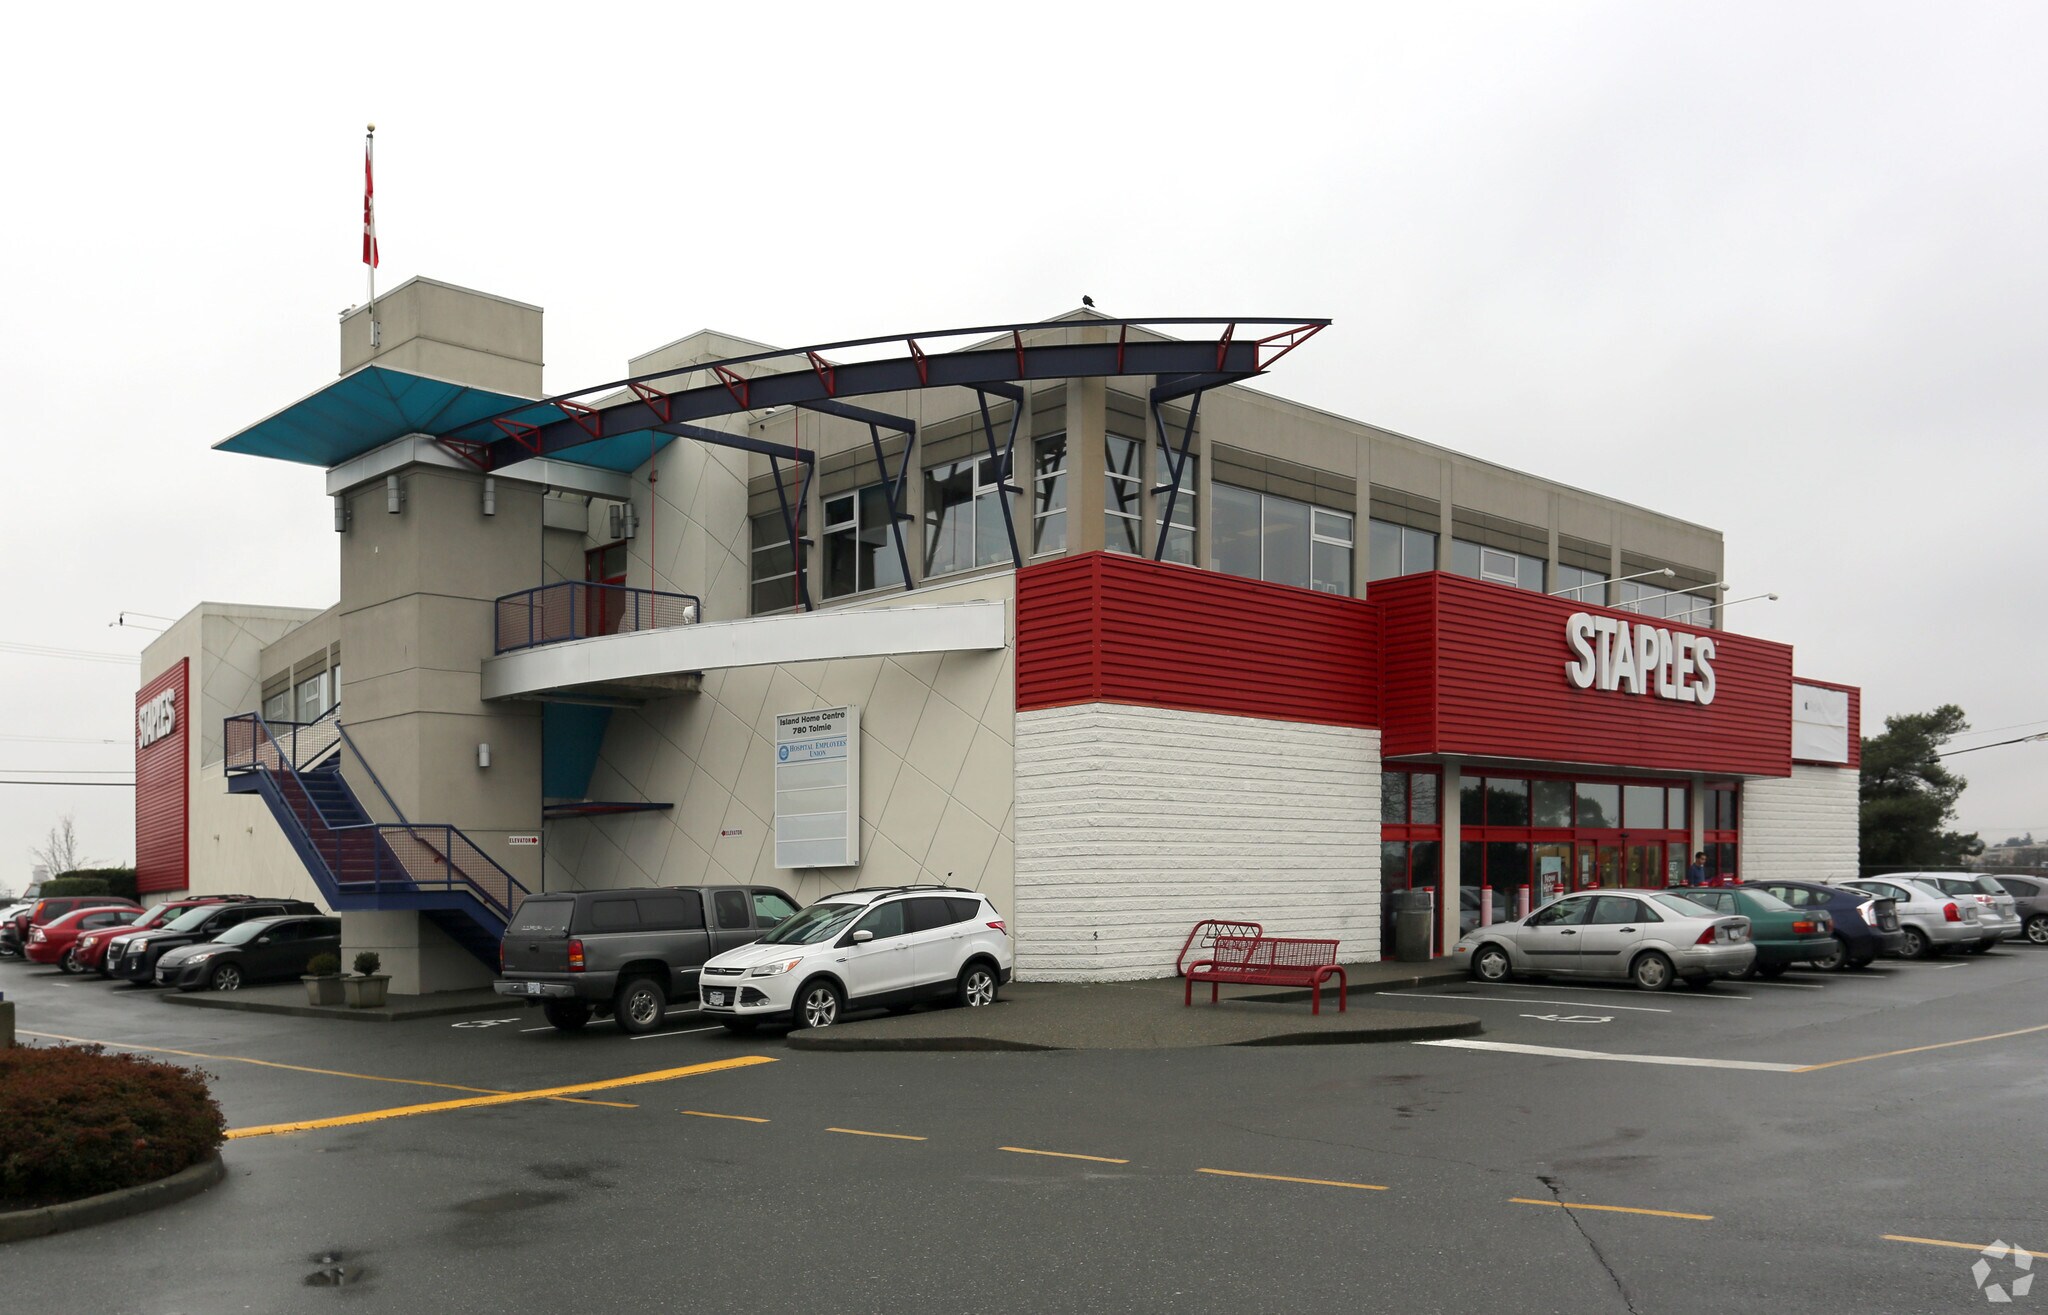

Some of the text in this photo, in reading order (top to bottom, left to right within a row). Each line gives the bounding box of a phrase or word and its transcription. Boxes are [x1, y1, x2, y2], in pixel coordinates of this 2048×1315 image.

[1565, 612, 1716, 705] STAPLES
[138, 688, 176, 749] STAPLES
[780, 712, 845, 726] Island Home Centre
[792, 723, 832, 734] 780 Tolmie
